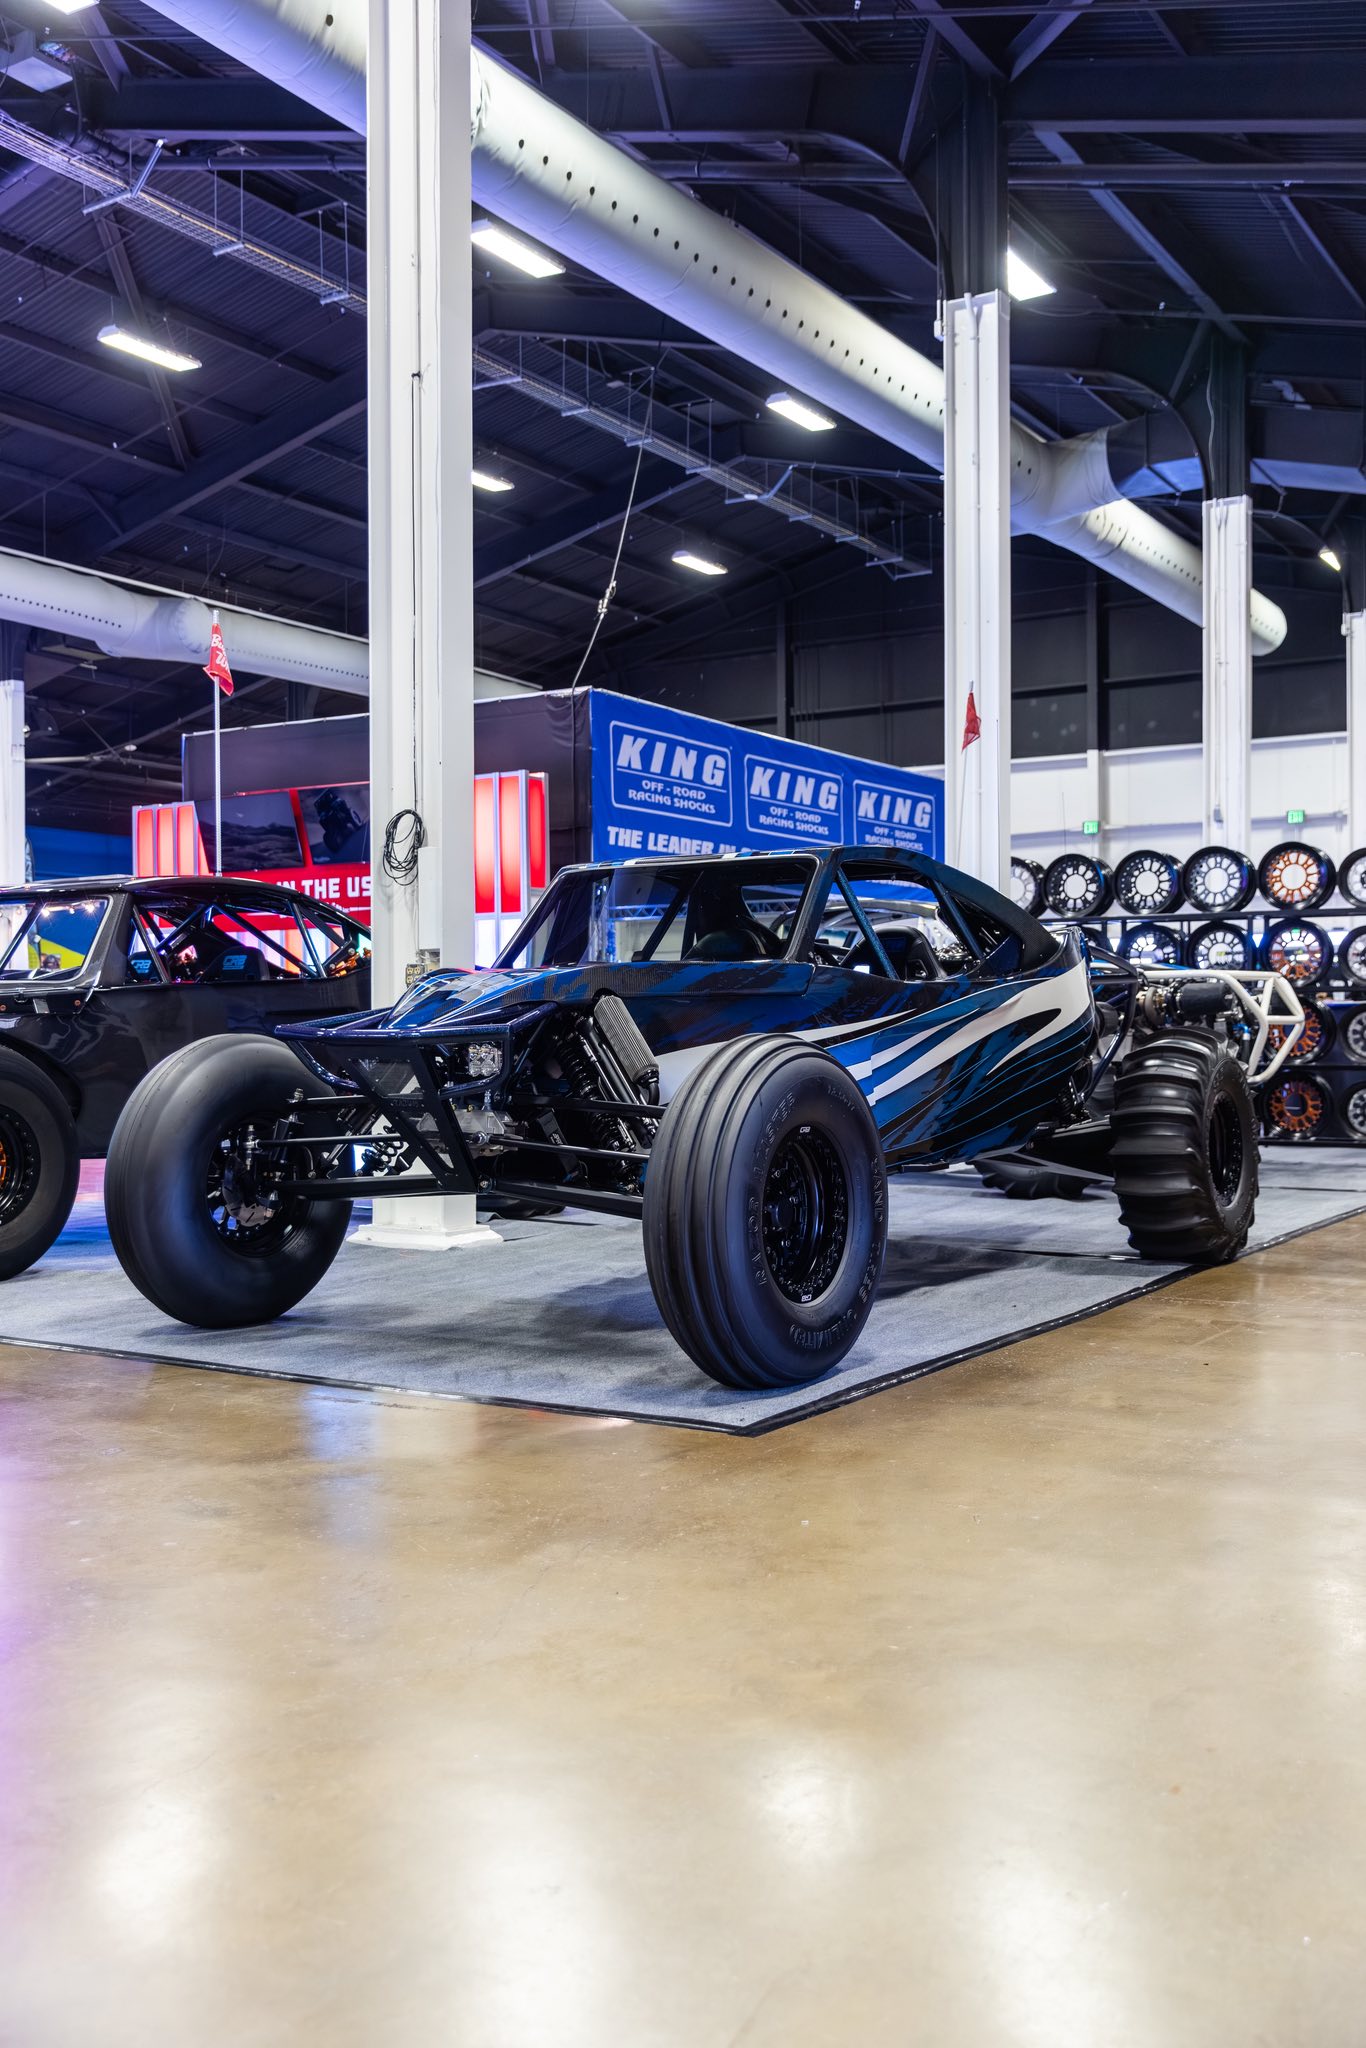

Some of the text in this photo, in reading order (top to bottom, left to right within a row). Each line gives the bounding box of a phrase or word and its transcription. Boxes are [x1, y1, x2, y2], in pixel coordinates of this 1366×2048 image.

[616, 734, 726, 787] KING
[641, 780, 664, 793] OFF
[673, 785, 706, 801] ROAD
[750, 765, 839, 810] KING
[628, 789, 716, 814] RACING SHOCKS
[857, 790, 932, 829] KING
[759, 814, 829, 836] RACING SHOCKS
[769, 806, 788, 818] OFF
[795, 811, 822, 823] ROAD
[607, 825, 643, 849] THE
[647, 832, 715, 856] LEADER
[873, 825, 889, 837] OFF
[894, 829, 917, 841] ROAD
[301, 877, 340, 899] THE
